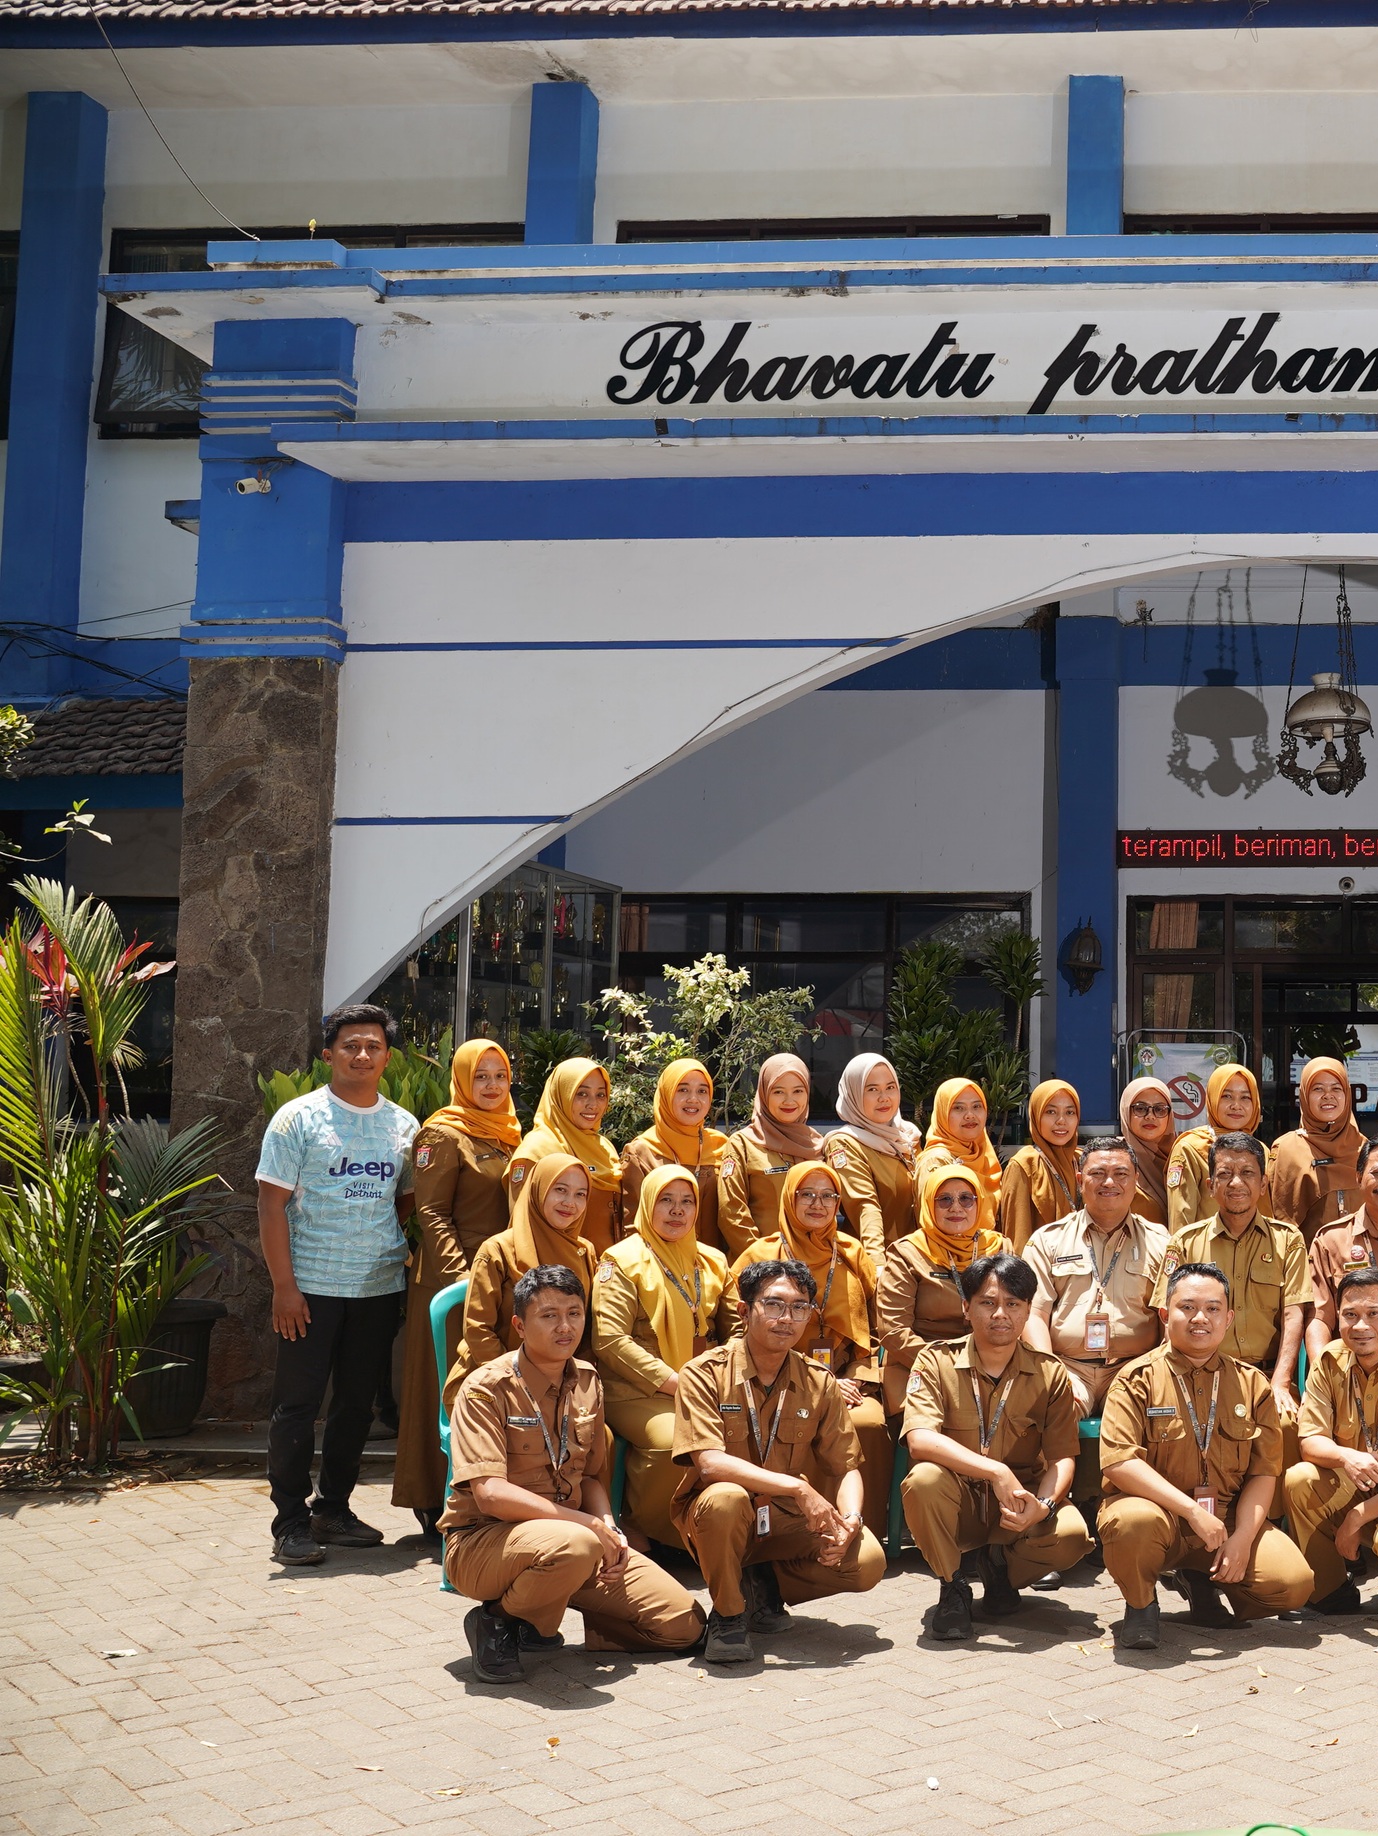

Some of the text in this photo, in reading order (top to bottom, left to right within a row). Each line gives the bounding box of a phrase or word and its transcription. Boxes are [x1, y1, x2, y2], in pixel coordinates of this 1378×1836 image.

[606, 321, 995, 404] Bhavatu
[1122, 834, 1226, 861] terampil,
[1235, 834, 1337, 859] beriman,
[329, 1157, 395, 1181] Jeep
[344, 1187, 383, 1199] Detroit
